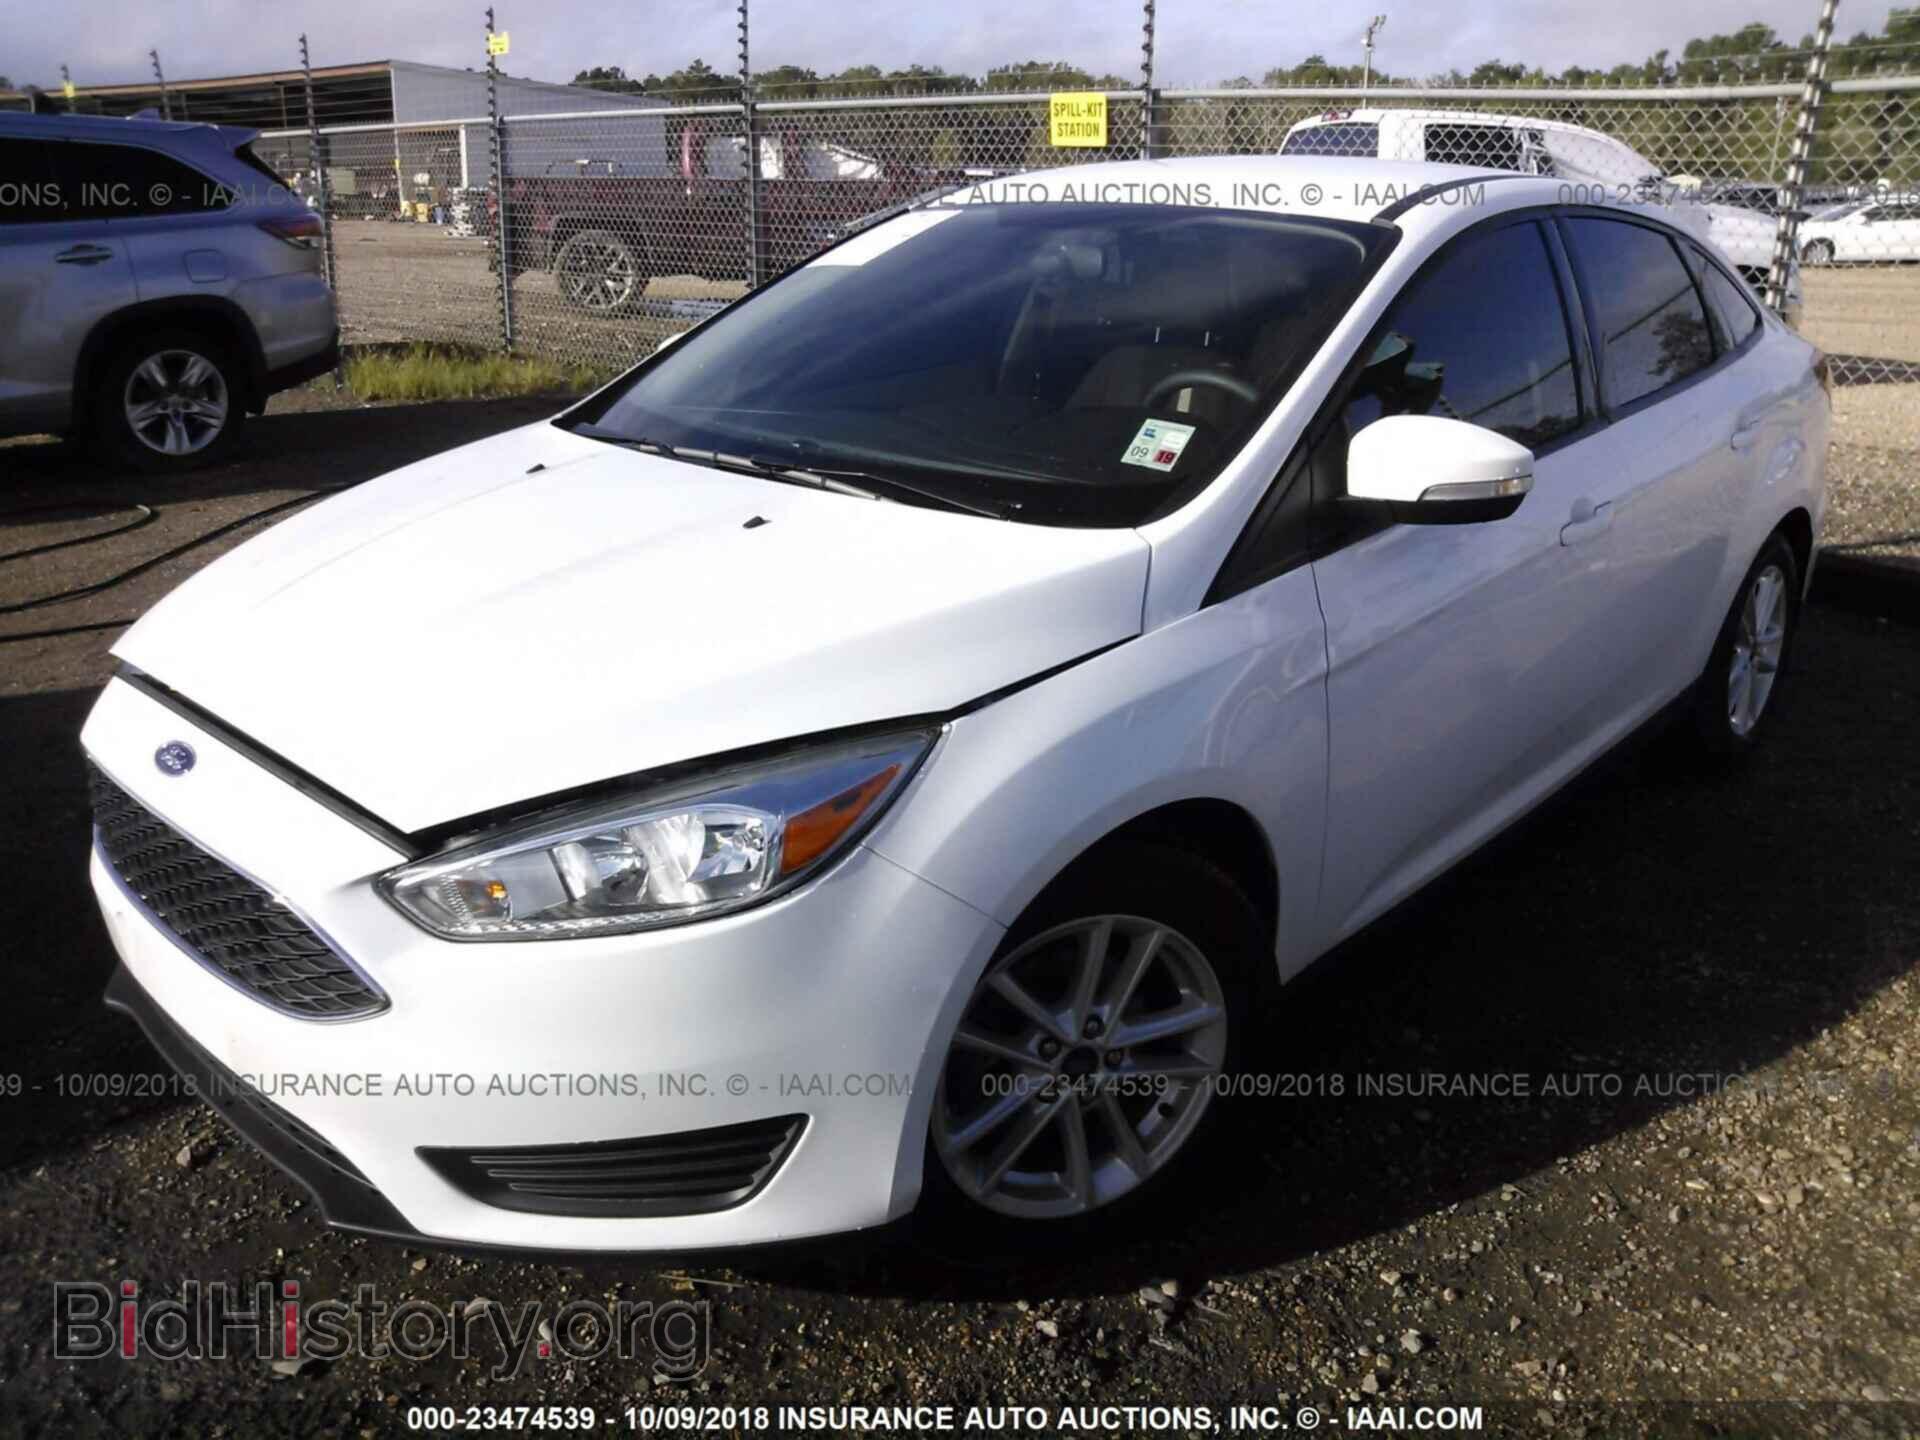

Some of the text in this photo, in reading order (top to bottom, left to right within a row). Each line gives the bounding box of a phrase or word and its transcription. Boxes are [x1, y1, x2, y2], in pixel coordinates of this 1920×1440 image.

[1053, 102, 1103, 117] SPILL-KIT
[1057, 122, 1100, 137] STATION
[1130, 446, 1149, 458] 09
